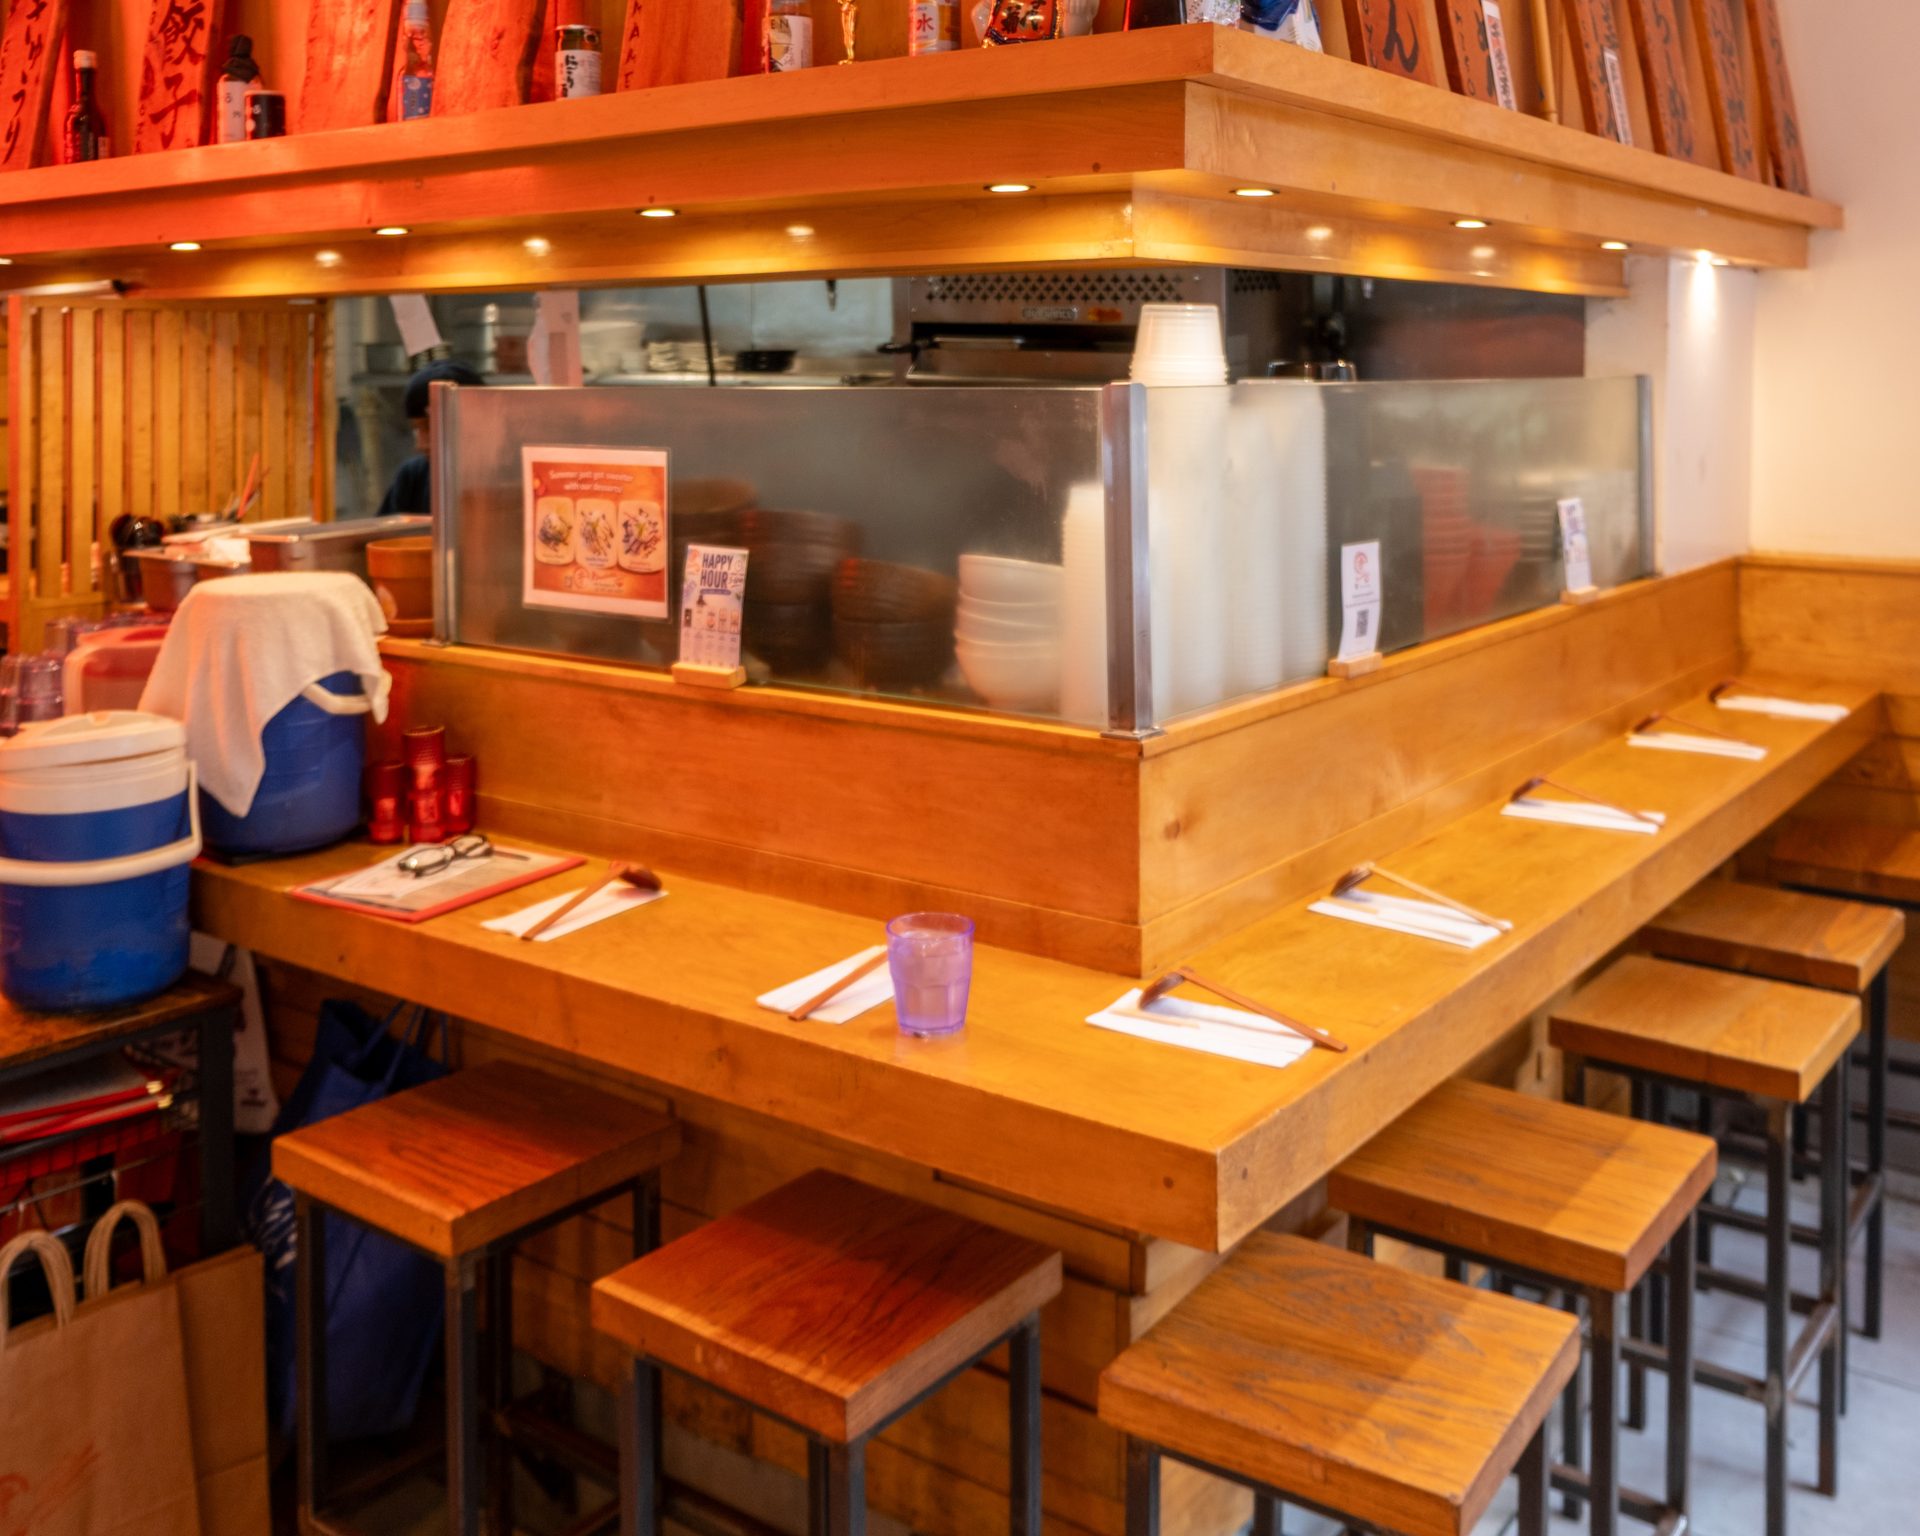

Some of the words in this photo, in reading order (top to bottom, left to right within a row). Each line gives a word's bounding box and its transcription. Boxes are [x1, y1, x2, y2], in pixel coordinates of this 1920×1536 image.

[916, 13, 934, 32] 水
[148, 0, 206, 150] 餃子
[702, 553, 734, 571] HAPPY
[700, 569, 728, 589] HOUR
